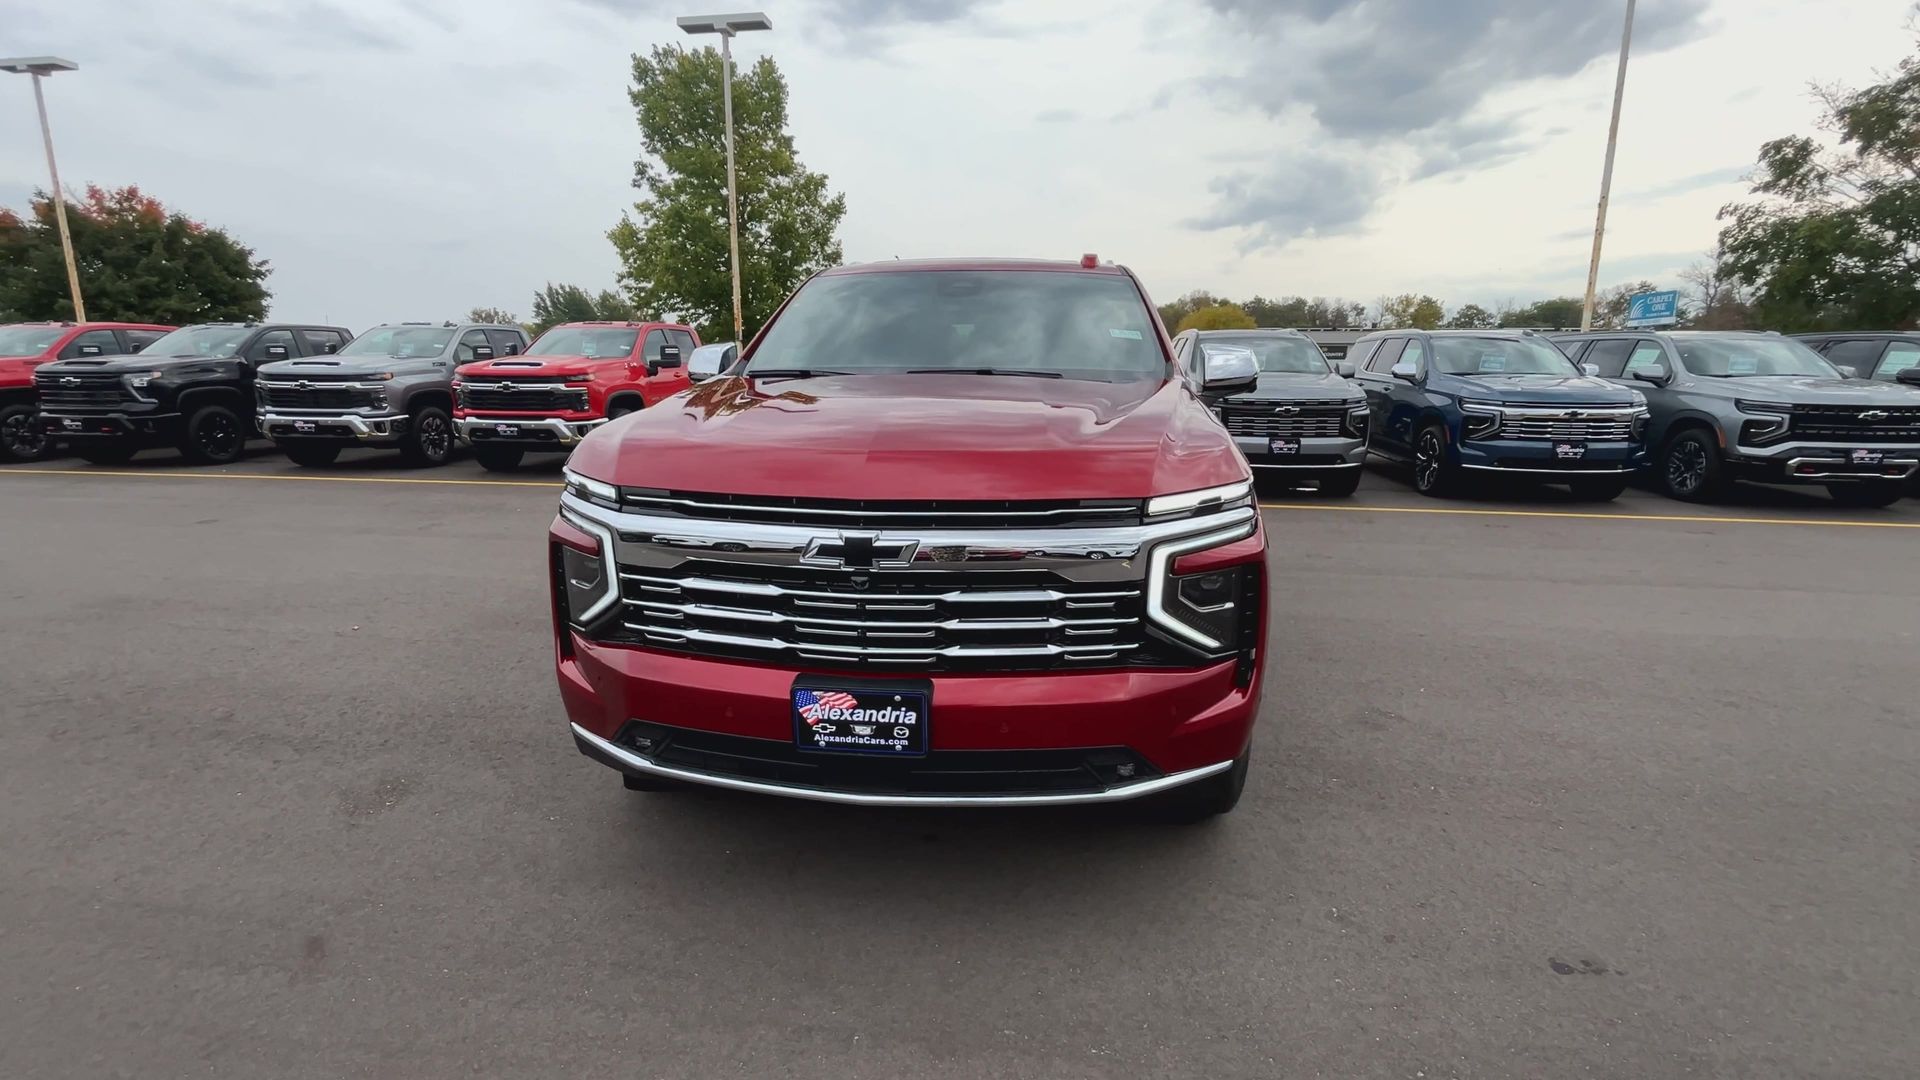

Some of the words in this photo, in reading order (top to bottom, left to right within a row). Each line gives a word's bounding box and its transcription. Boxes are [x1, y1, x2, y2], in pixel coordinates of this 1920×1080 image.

[1647, 294, 1674, 304] CARPET
[1652, 303, 1667, 312] ONE
[807, 703, 917, 724] Alexandria
[814, 733, 909, 746] AlexandriaCars.com
